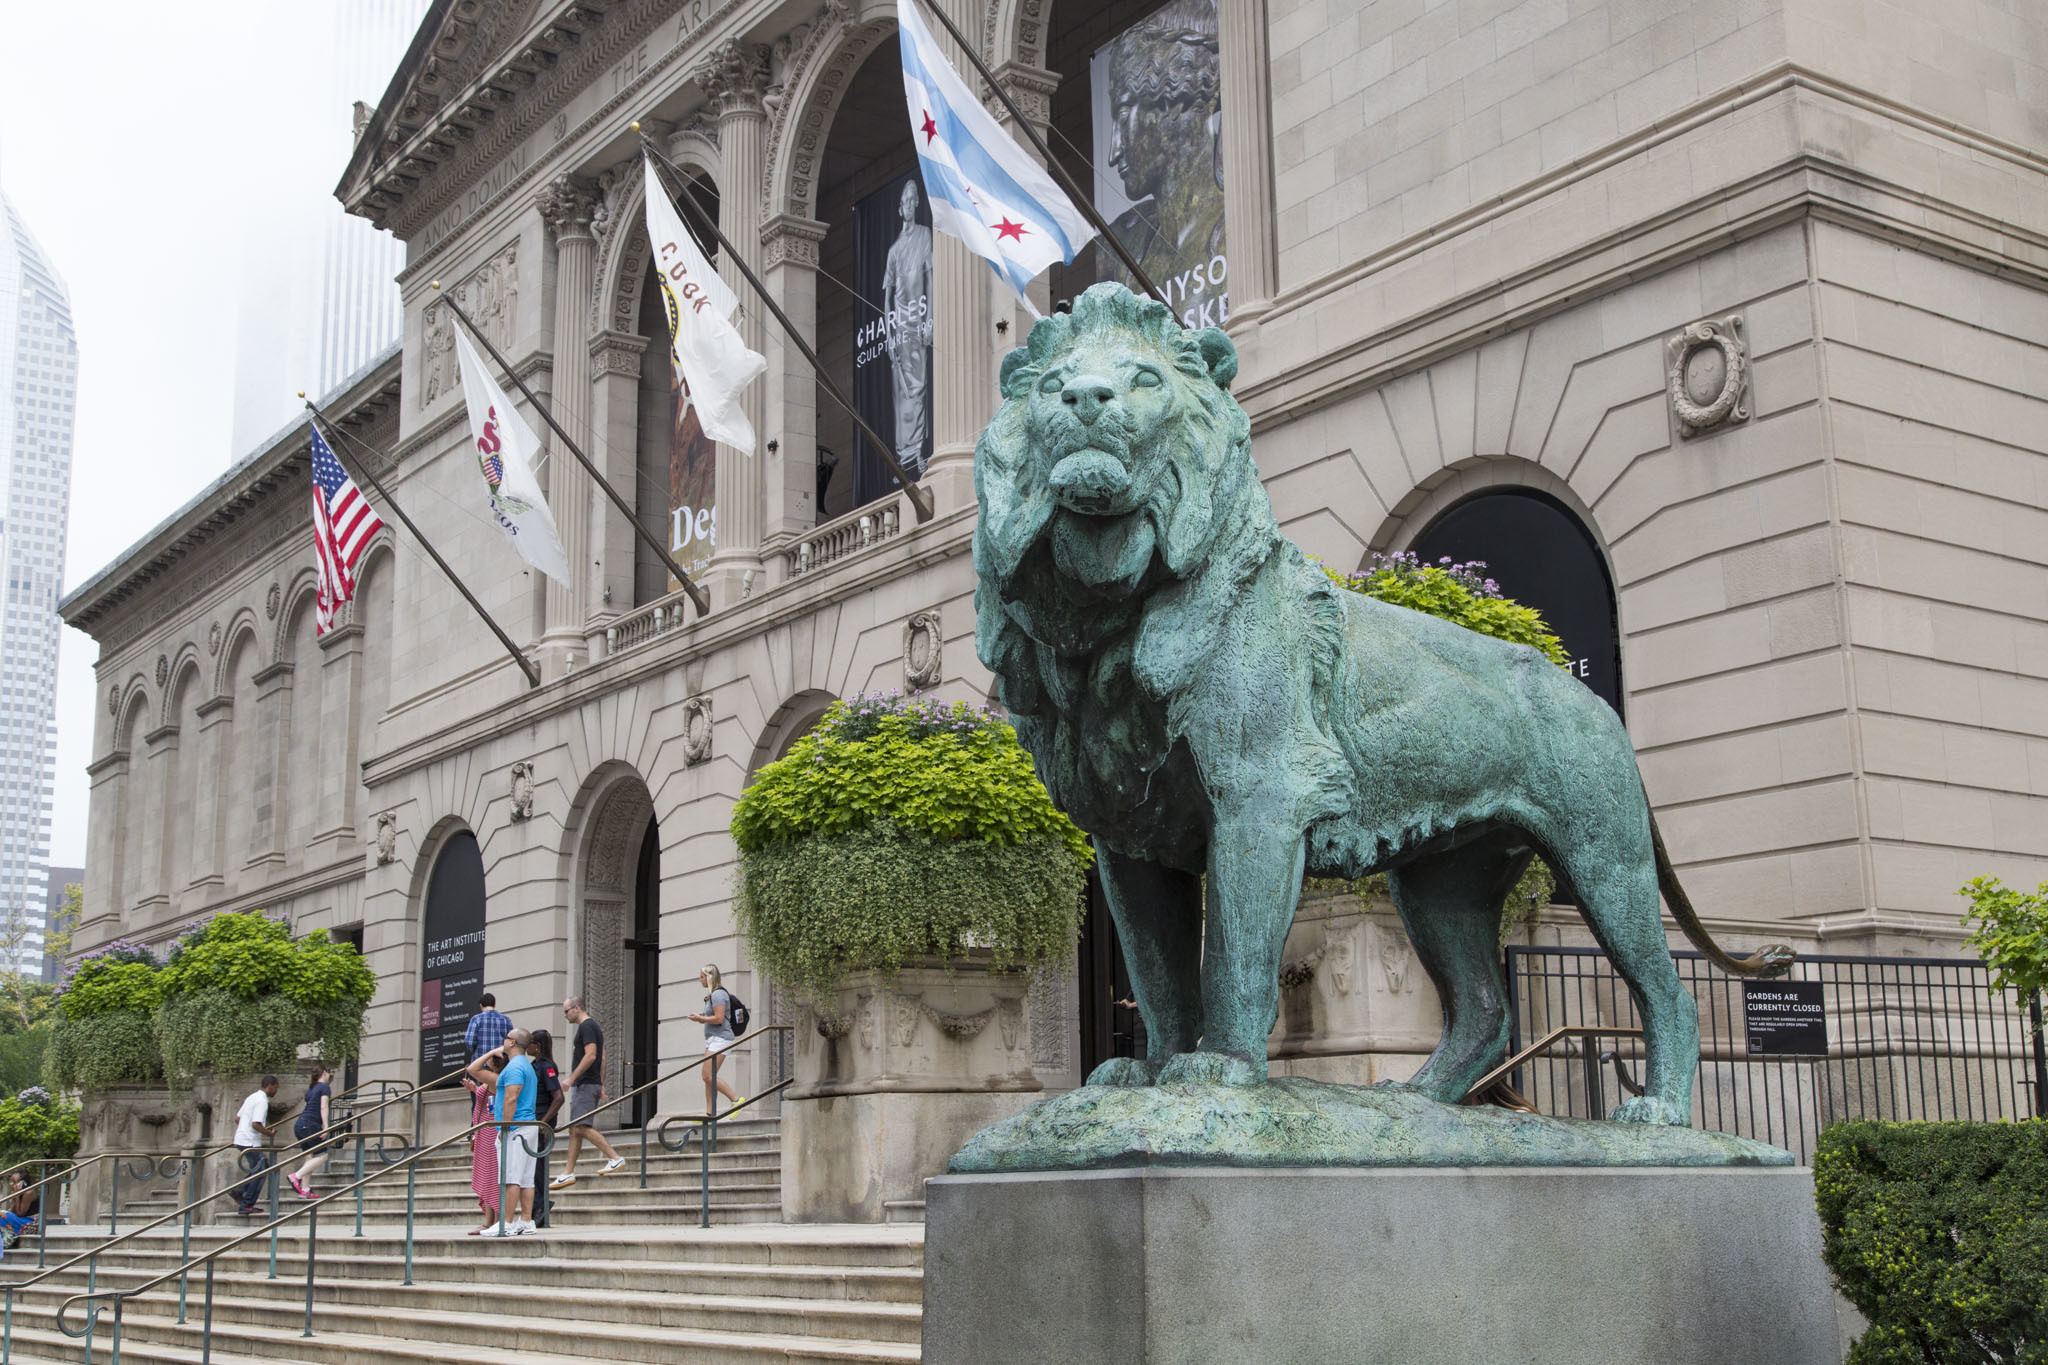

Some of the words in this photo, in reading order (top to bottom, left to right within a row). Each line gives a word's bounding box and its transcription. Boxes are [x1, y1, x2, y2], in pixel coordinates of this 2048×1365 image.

[611, 44, 647, 95] THE
[423, 203, 461, 254] ANNO
[468, 148, 526, 215] DOMINI
[857, 294, 928, 349] CHARLES
[428, 941, 439, 953] THE
[440, 937, 452, 950] ART
[453, 930, 486, 948] INSTITUTE
[427, 957, 435, 969] OF
[436, 950, 464, 967] CHICAGO
[1746, 992, 1782, 1001] GARDENS
[1784, 993, 1799, 1001] ARE
[1747, 1003, 1791, 1012] CURRENTLY
[1792, 1004, 1823, 1013] CLOSED.
